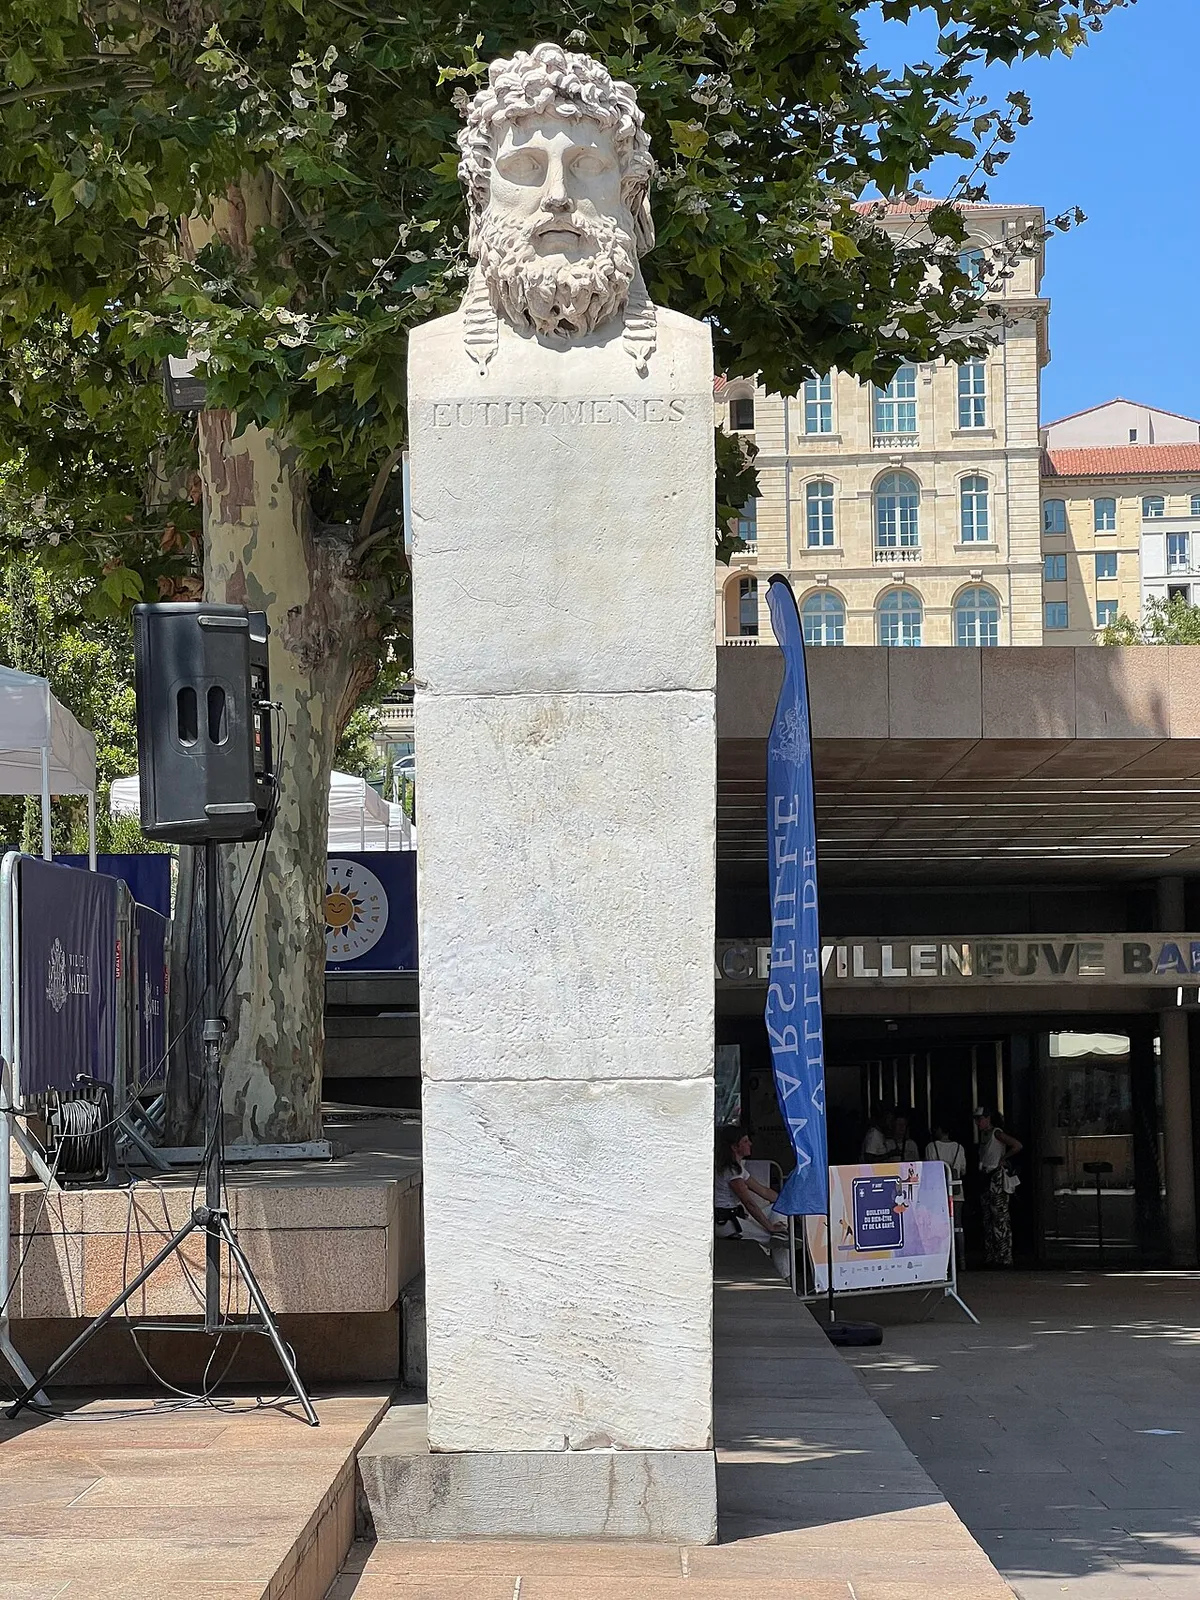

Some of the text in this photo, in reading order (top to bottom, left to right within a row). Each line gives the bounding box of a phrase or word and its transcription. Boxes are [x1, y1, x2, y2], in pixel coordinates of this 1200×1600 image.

[430, 397, 687, 428] EUTHYMENES
[331, 866, 355, 877] TÉ
[331, 894, 382, 954] SEILLAIS
[714, 945, 772, 980] CE
